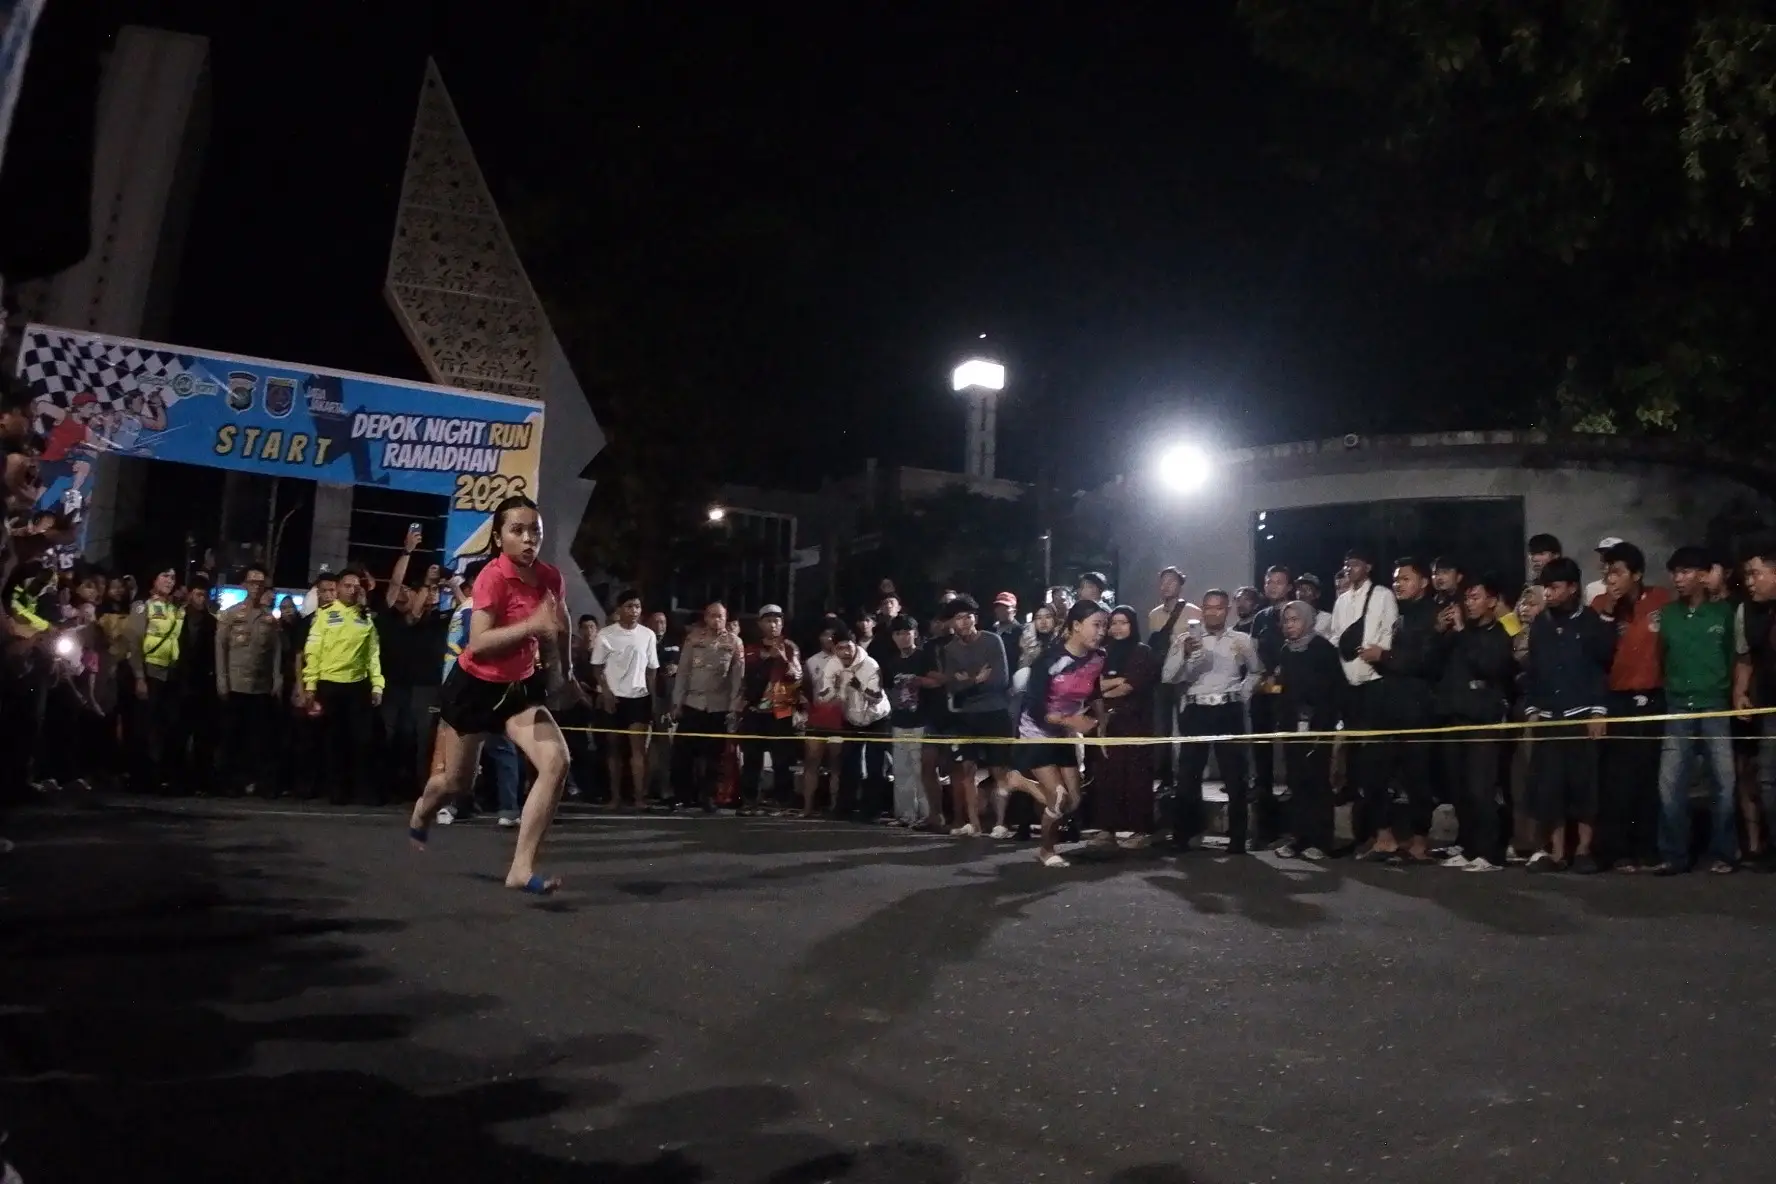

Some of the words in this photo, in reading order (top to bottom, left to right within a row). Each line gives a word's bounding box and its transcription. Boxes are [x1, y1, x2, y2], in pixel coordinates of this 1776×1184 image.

[215, 425, 333, 466] START
[351, 413, 422, 442] DEPOK
[423, 417, 487, 446] NIGHT
[488, 422, 531, 449] RUN
[383, 442, 500, 473] RAMADHAN
